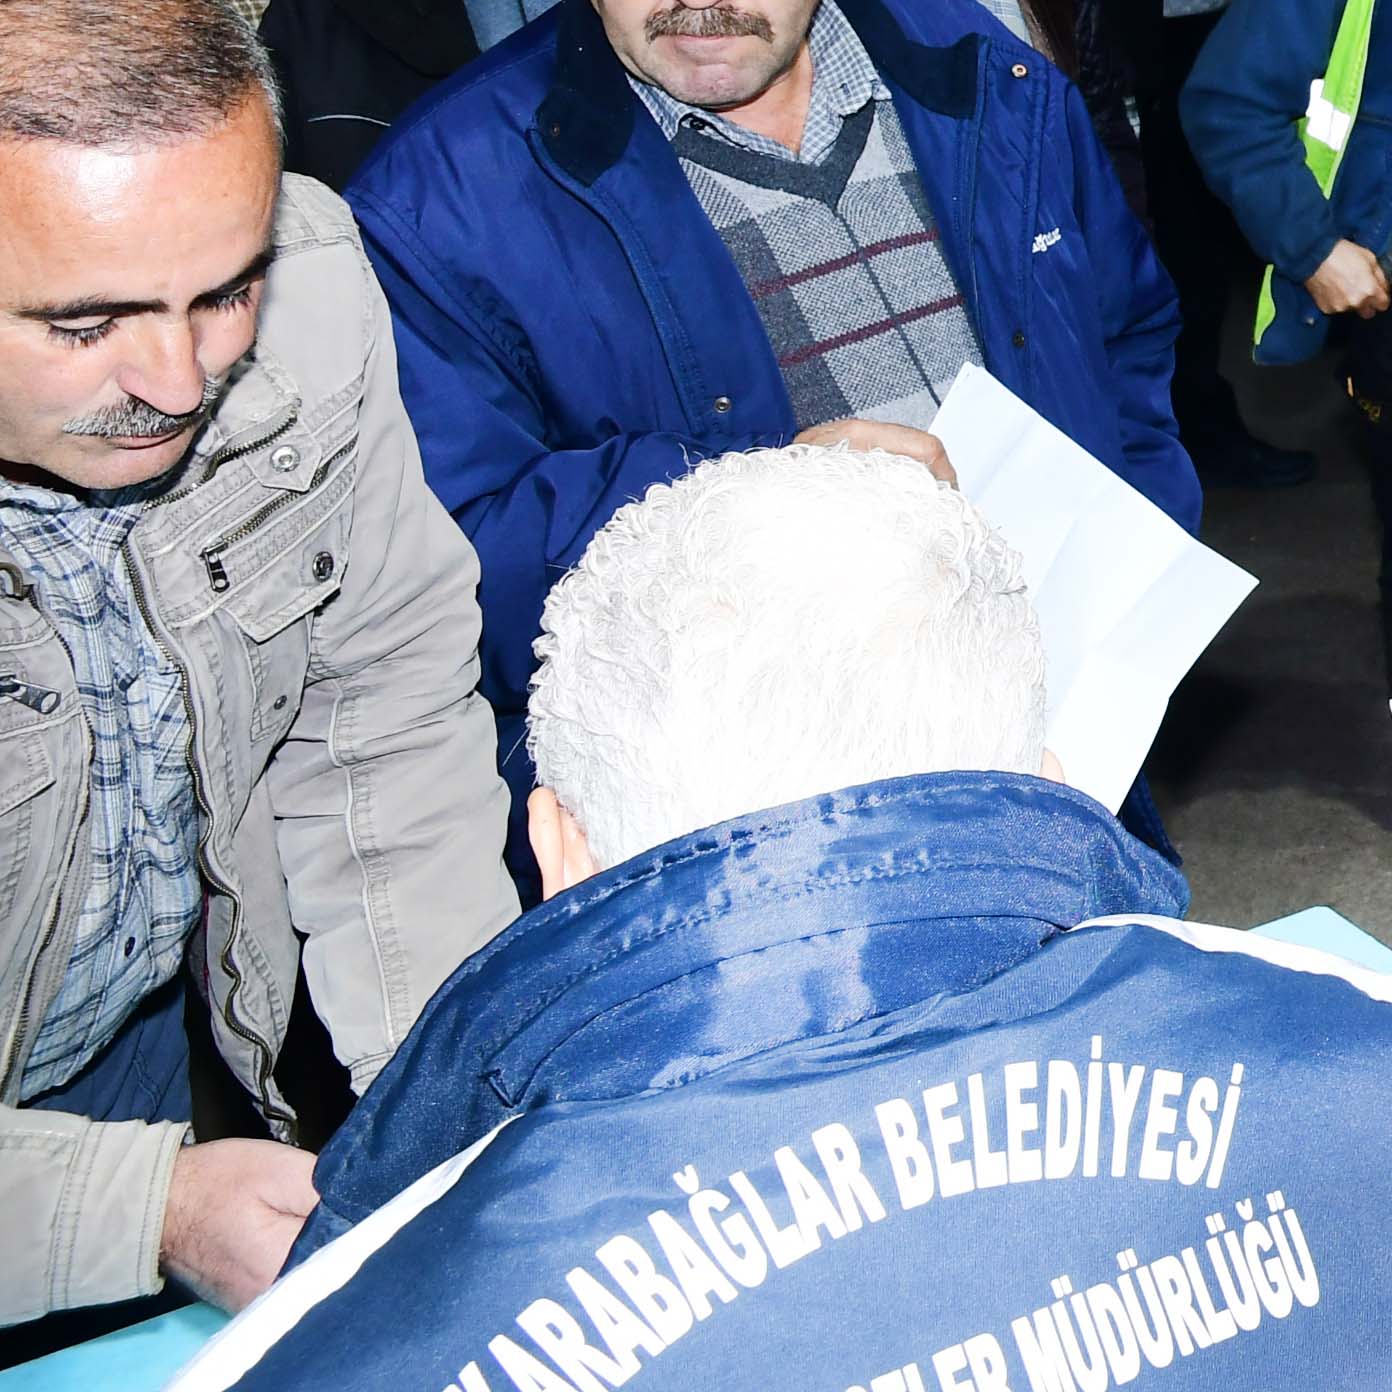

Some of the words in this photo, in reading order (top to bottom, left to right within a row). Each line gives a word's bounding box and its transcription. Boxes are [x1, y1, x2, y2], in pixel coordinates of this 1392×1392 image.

[442, 1165, 887, 1392] ARABAĞLAR
[874, 1035, 1244, 1210] BELEDİYESİ
[1011, 1190, 1320, 1392] MÜDÜRLÜĞÜ
